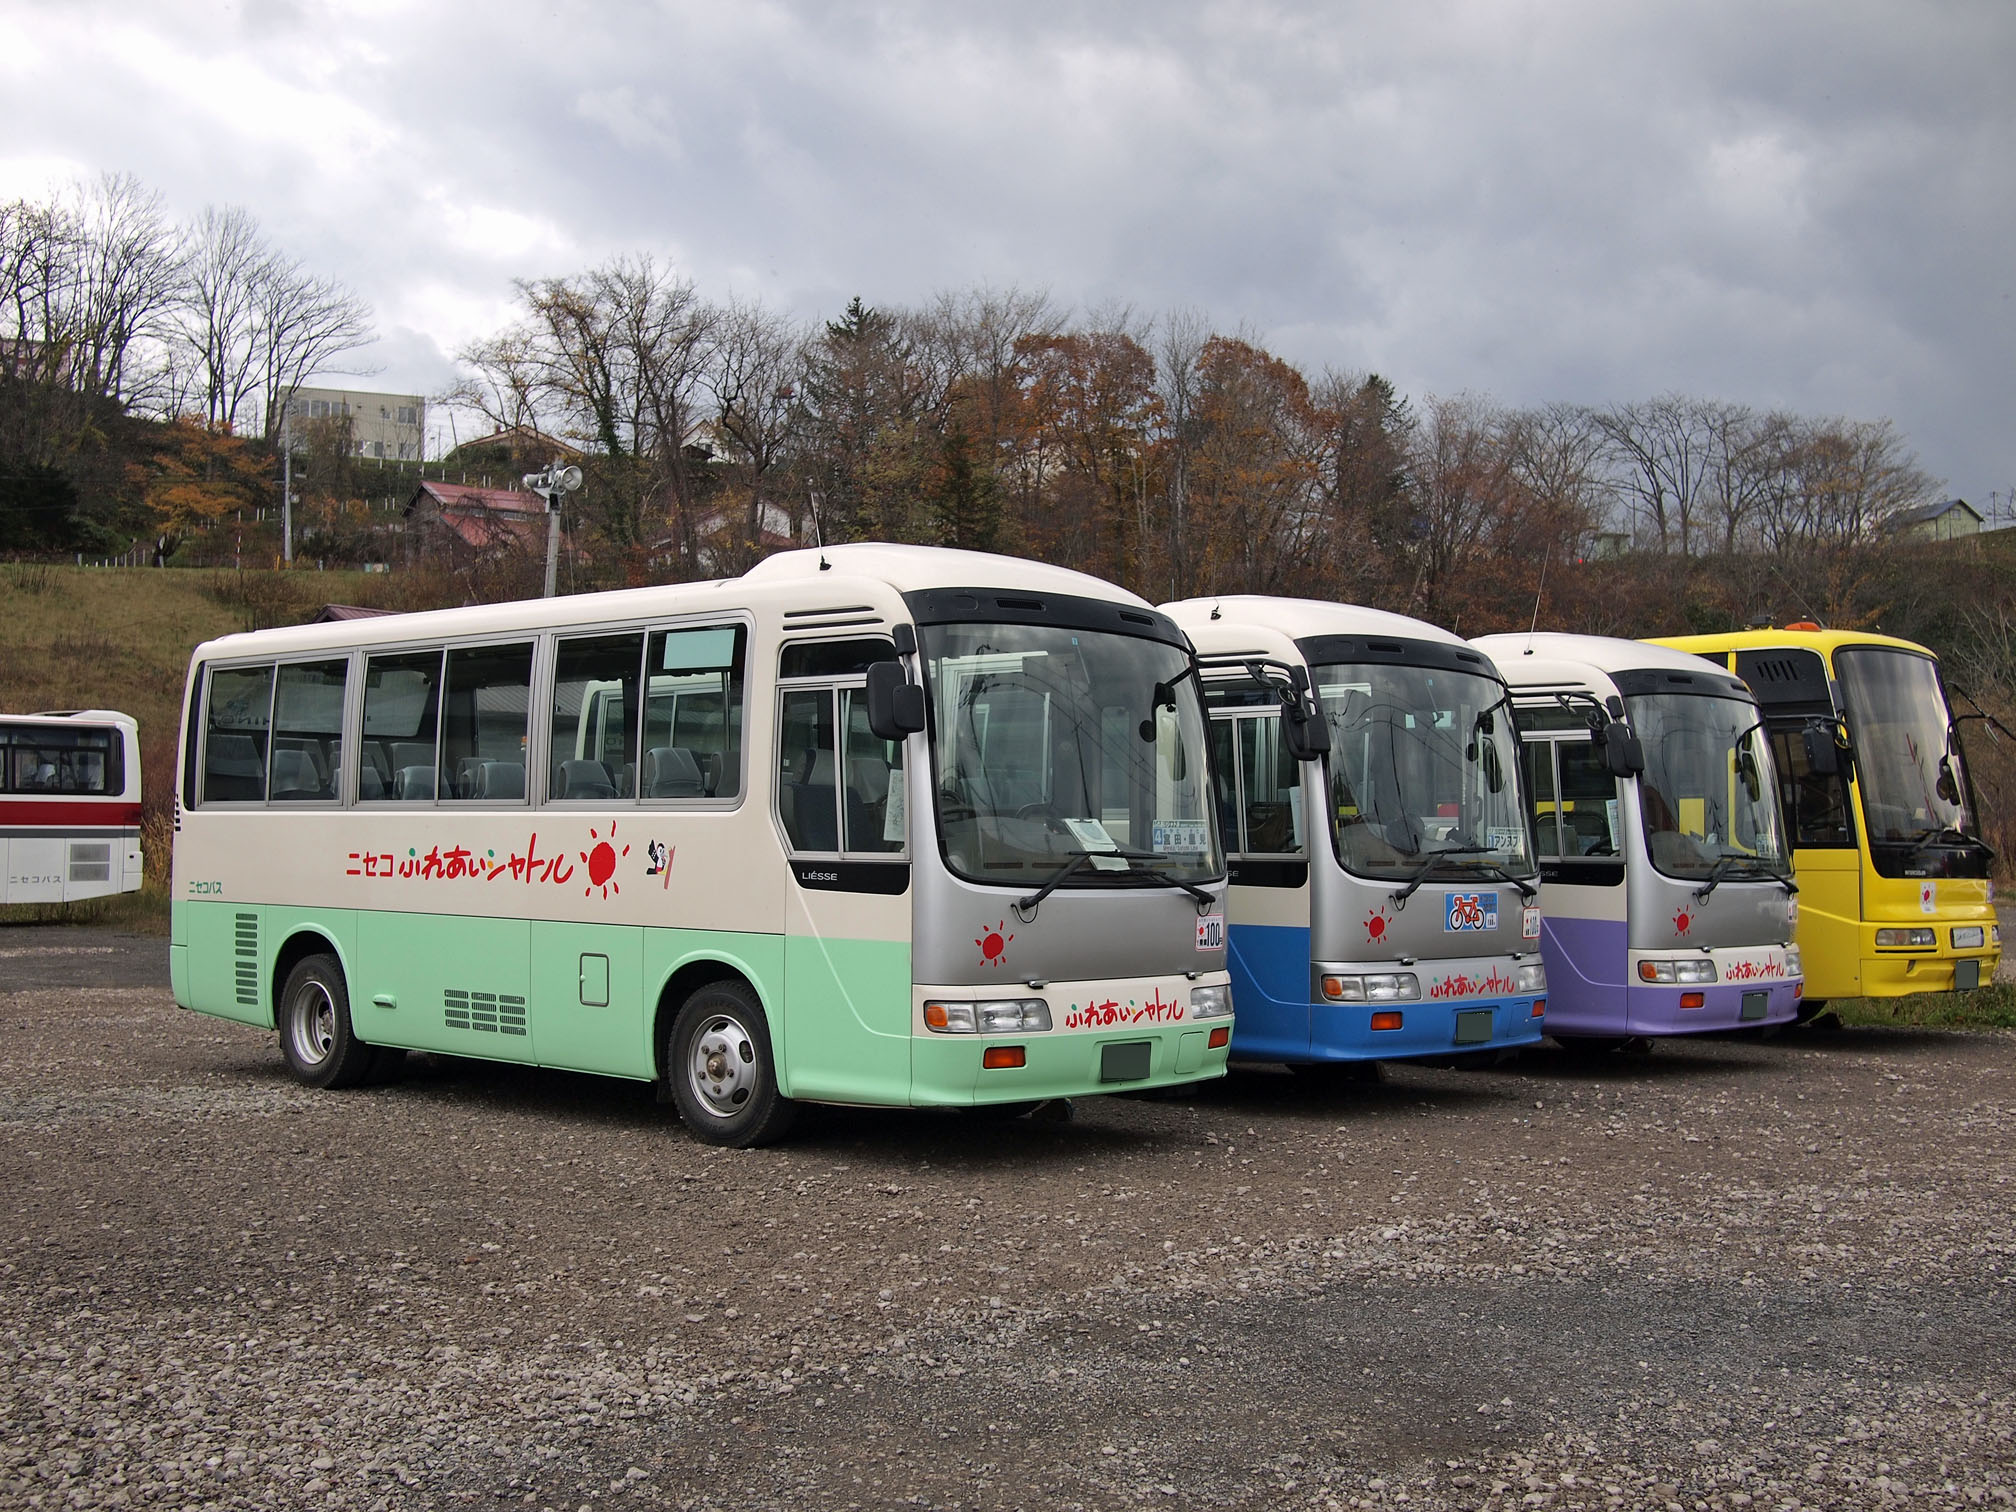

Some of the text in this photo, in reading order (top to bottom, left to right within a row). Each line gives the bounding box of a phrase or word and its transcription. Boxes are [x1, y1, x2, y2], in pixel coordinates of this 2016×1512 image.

[346, 832, 574, 884] ニセコ ふれあいシャトル
[9, 875, 62, 884] ニセコバス
[801, 870, 838, 881] LIÉSSE
[189, 881, 223, 894] ニセコバス
[1430, 965, 1515, 998] ふれあいシャトル
[1066, 987, 1184, 1028] ふれあいシャトル
